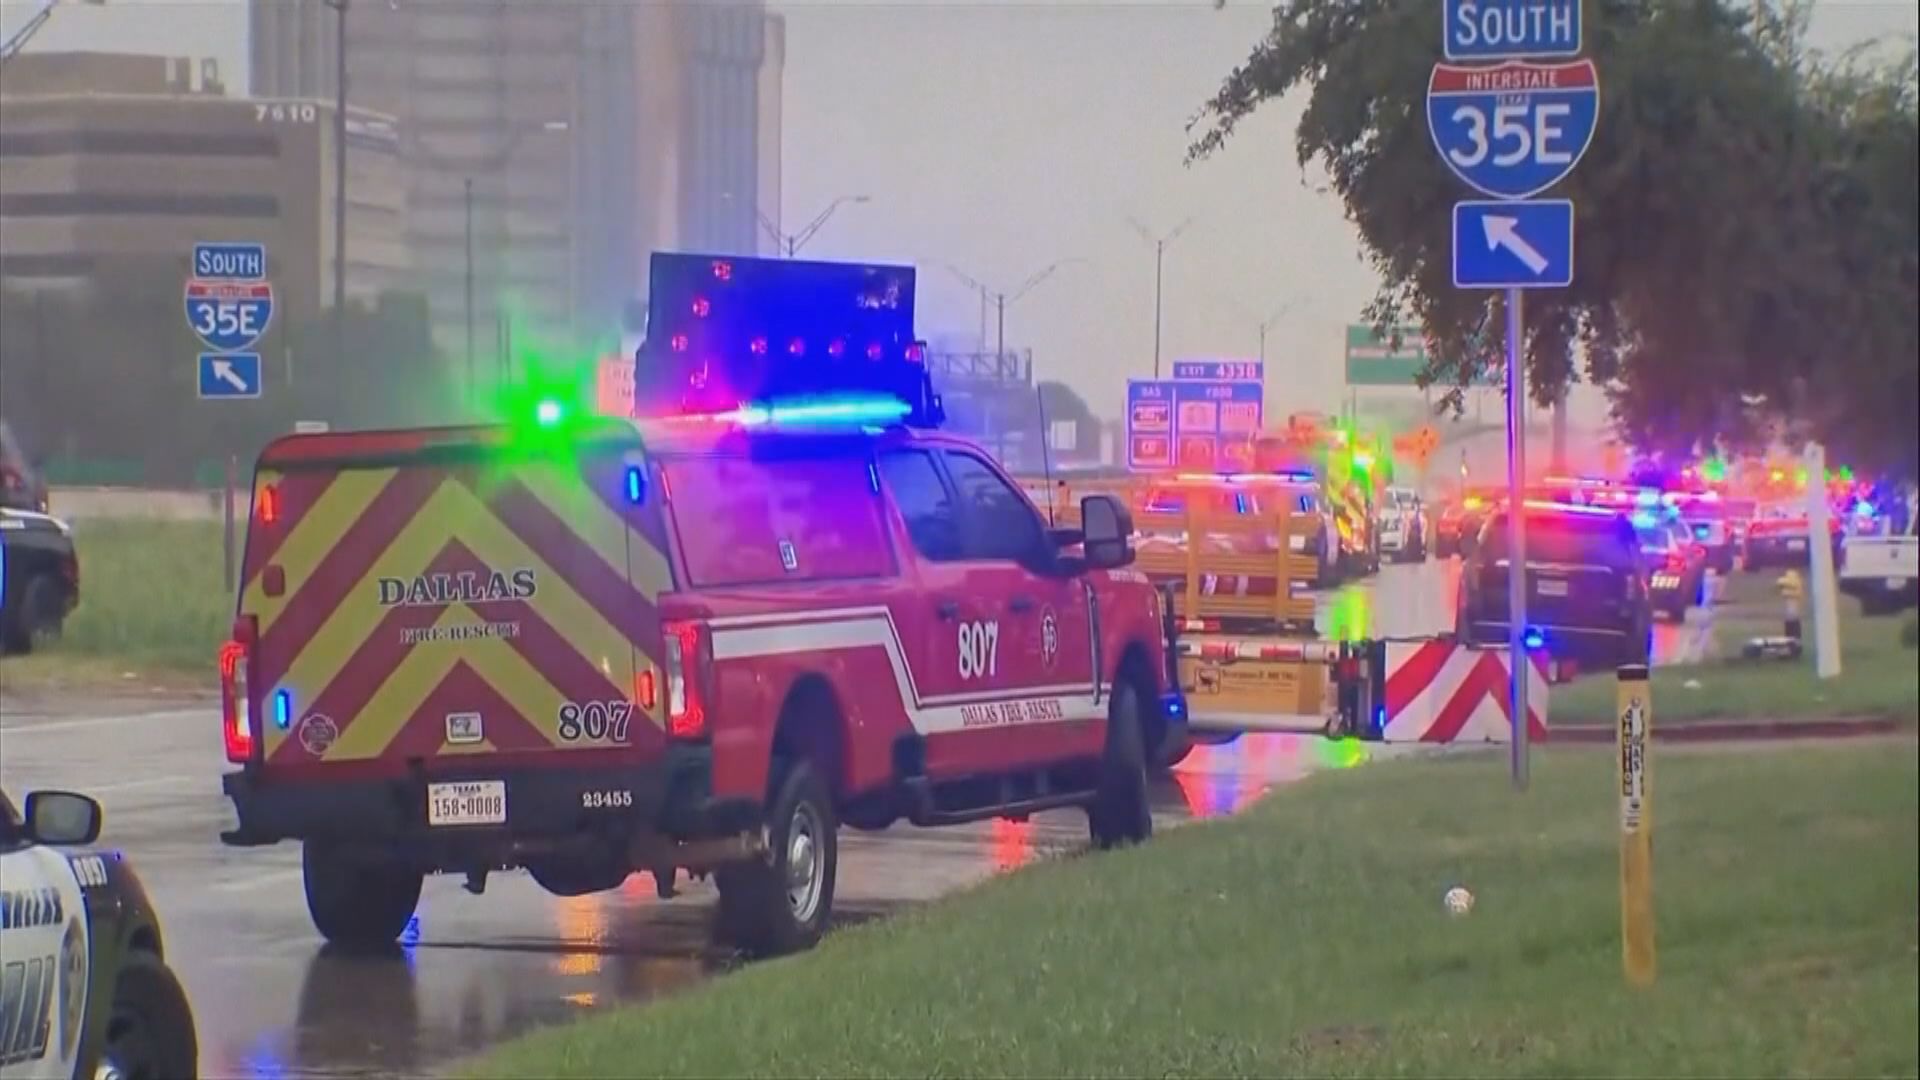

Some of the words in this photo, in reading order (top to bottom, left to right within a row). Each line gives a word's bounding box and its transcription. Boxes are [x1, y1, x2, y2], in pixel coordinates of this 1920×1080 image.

[1456, 4, 1570, 46] SOUTH
[1466, 70, 1558, 90] INTERSTATE
[255, 104, 315, 122] 7610
[1450, 104, 1572, 168] 35E
[198, 249, 260, 275] SOUTH
[196, 303, 259, 336] 35E
[378, 568, 537, 605] DALLAS
[957, 620, 999, 680] 807
[558, 700, 633, 742] 807
[961, 703, 998, 726] DALLAS
[452, 785, 481, 793] TEXAS
[582, 790, 632, 807] 23455
